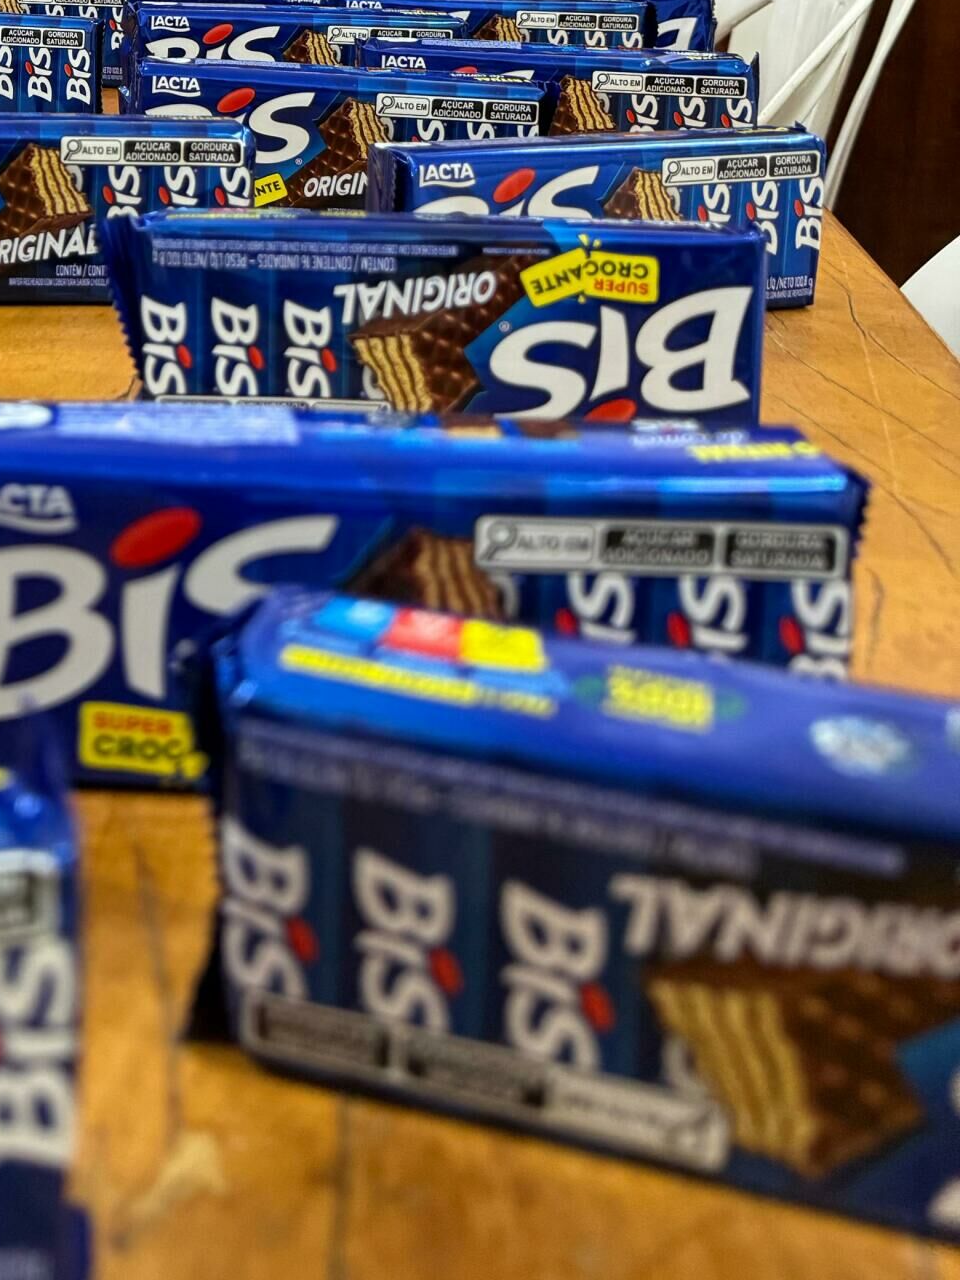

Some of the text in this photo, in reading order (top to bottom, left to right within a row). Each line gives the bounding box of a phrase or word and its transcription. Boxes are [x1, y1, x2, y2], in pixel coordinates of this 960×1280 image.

[152, 15, 190, 30] LACTA
[2, 36, 40, 45] ADICIONADO
[47, 31, 79, 39] GORDURA
[46, 38, 80, 47] SATURADA
[381, 54, 426, 68] LACTA
[25, 46, 52, 103] BiS
[64, 47, 91, 105] BiS
[152, 76, 201, 96] LACTA
[609, 78, 641, 88] ALTO EM
[702, 78, 740, 88] GORDURA
[646, 84, 693, 95] ADICIONADO
[700, 87, 741, 97] SATURADA
[394, 101, 427, 112] ALTO EM
[491, 103, 532, 114] GORDURA
[432, 109, 482, 120] ADICIONADO
[490, 112, 533, 123] SATURADA
[81, 144, 119, 157] ALTO EM
[189, 141, 235, 152] GORDURA
[125, 150, 180, 163] ADICIONADO
[188, 151, 236, 163] SATURADA
[775, 154, 812, 166] GORDURA
[419, 163, 475, 186] LACTA
[680, 165, 714, 177] ALTO EM
[718, 167, 767, 180] ADICIONADO
[773, 165, 813, 176] SATURADA
[303, 173, 368, 198] ORIGIN
[793, 177, 824, 250] BiS
[529, 261, 650, 295] CROCANTE
[593, 278, 650, 296] SUPER
[333, 272, 499, 325] ORIGINAL
[490, 287, 754, 420] BiS
[92, 710, 177, 733] SUPER
